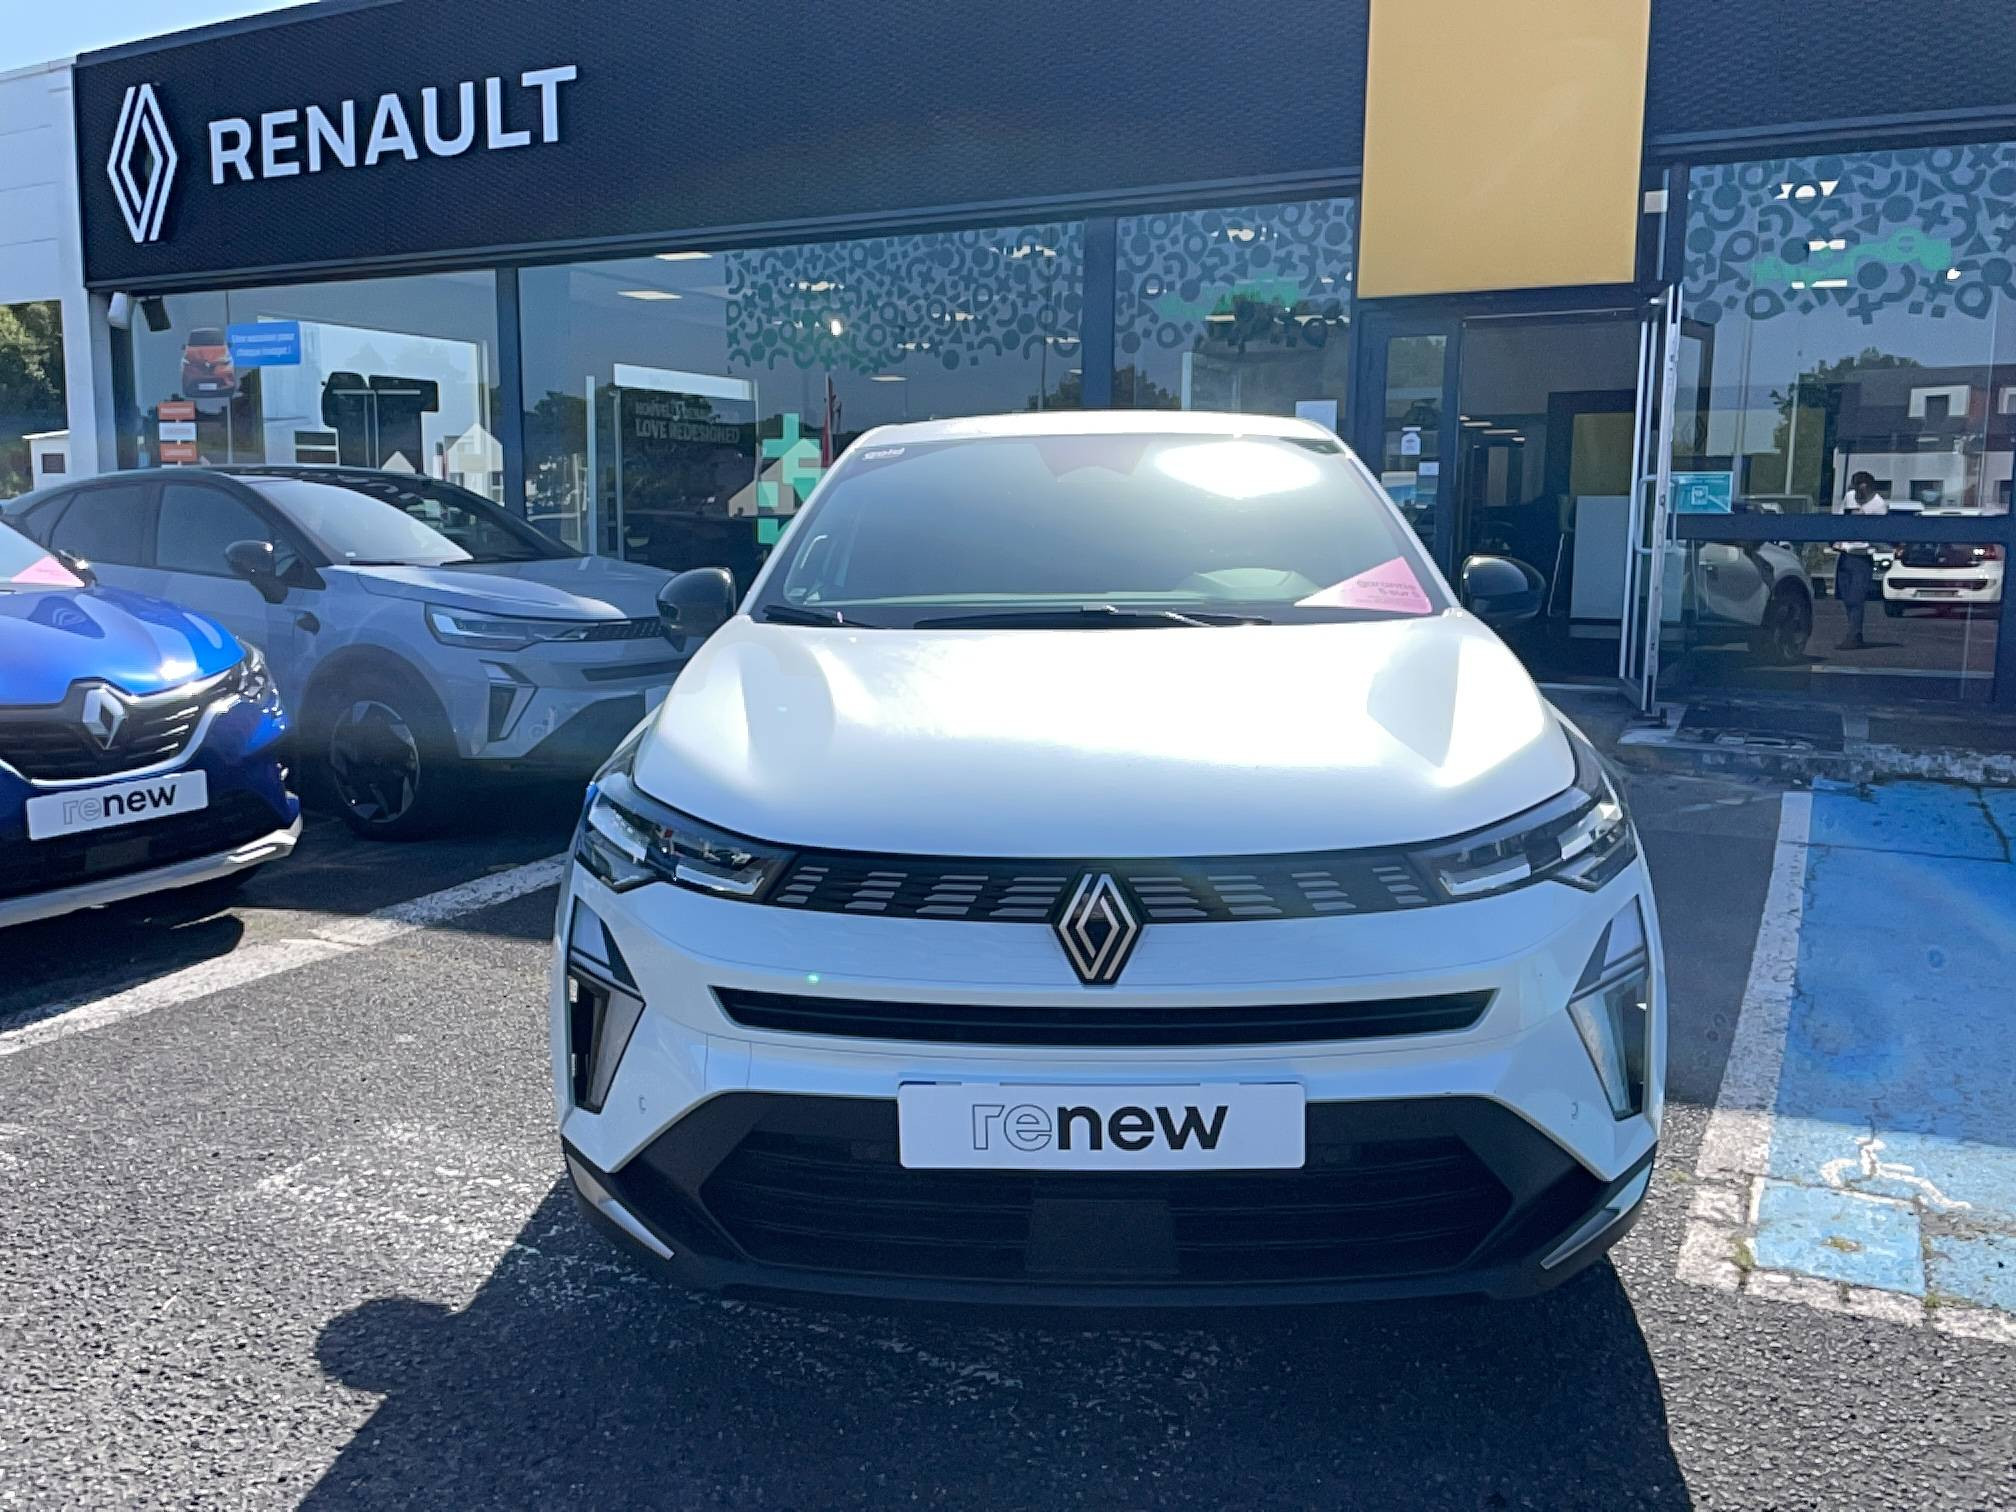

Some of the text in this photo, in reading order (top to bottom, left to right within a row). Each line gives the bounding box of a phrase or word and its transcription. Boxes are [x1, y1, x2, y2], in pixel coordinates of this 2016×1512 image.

[208, 64, 577, 185] RENAULT
[635, 418, 668, 439] LOVE
[63, 784, 177, 825] renew
[972, 1103, 1229, 1152] renew
